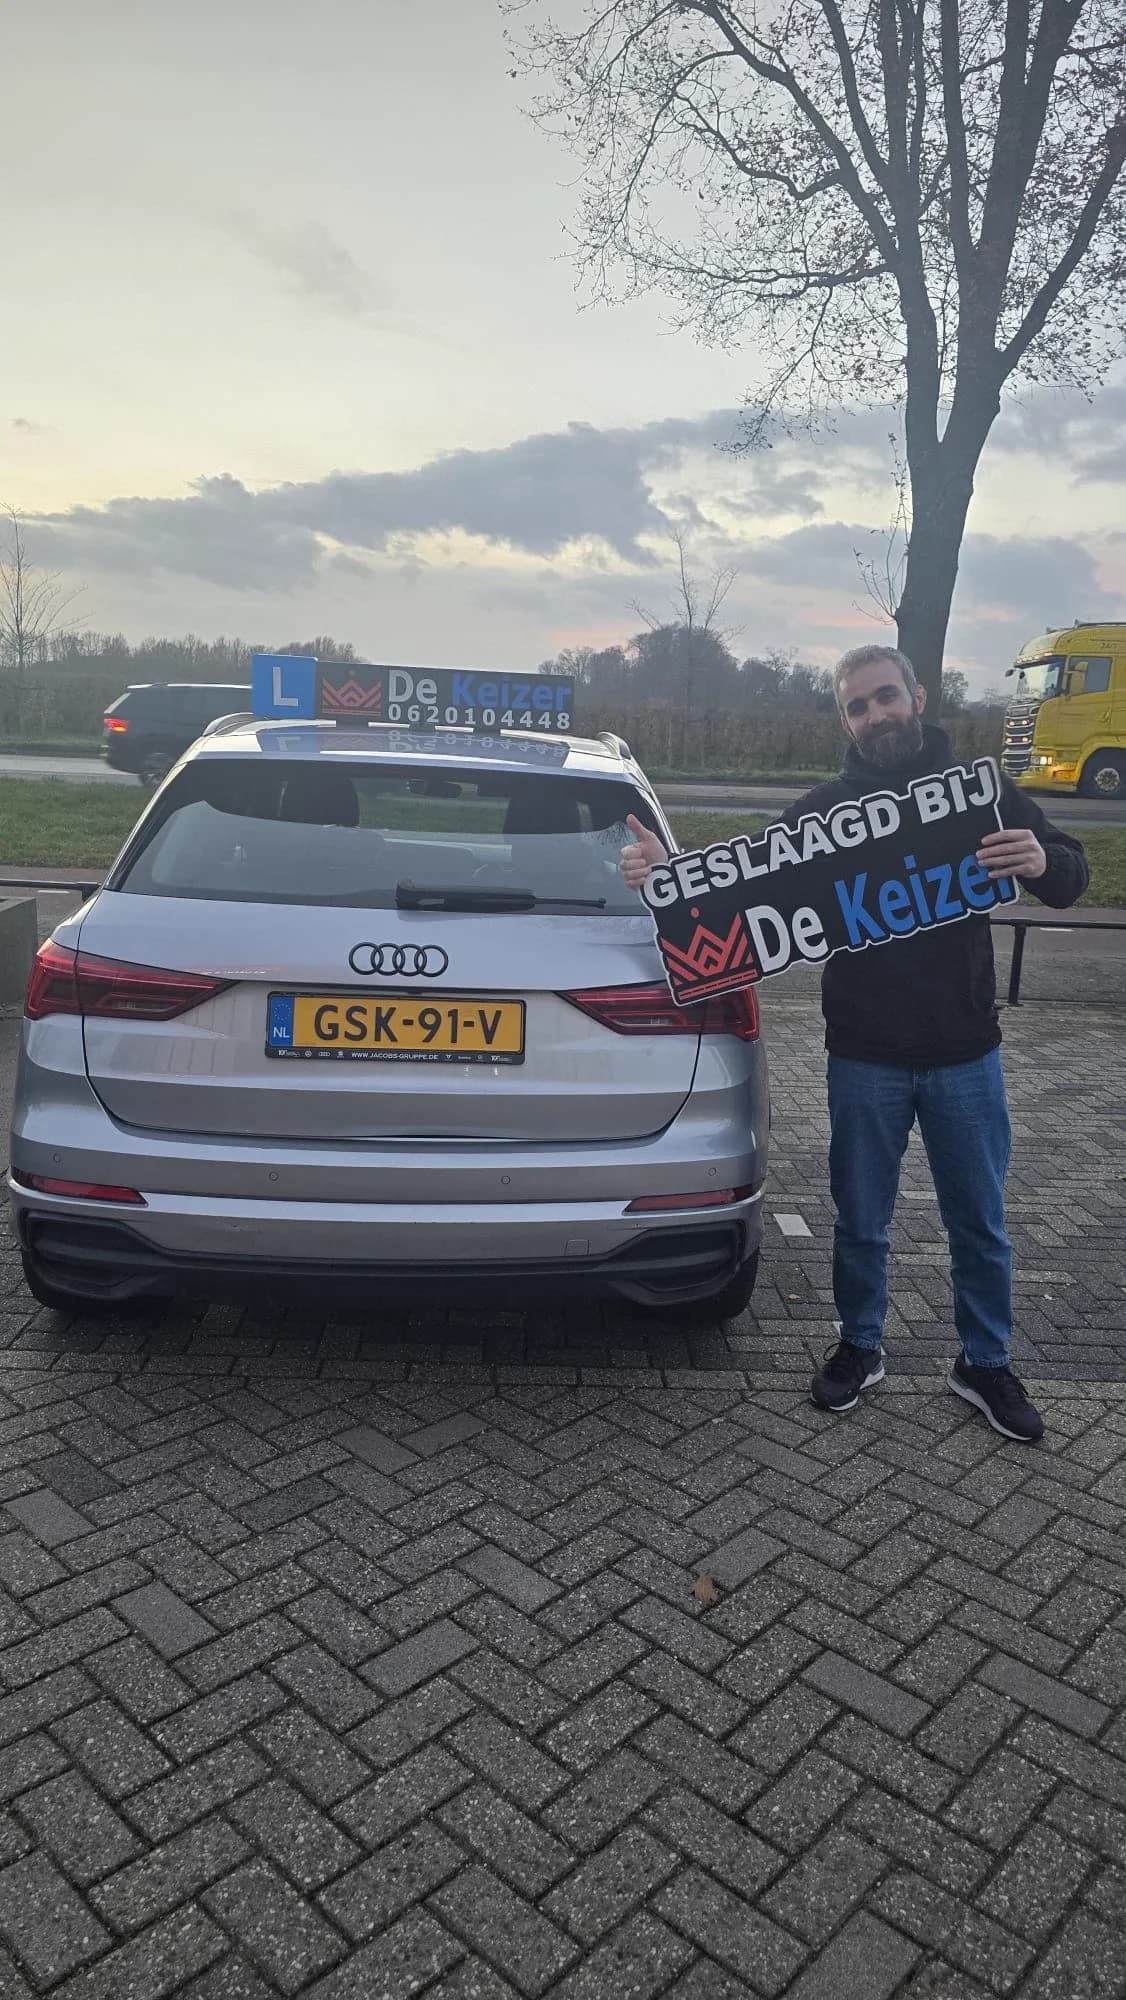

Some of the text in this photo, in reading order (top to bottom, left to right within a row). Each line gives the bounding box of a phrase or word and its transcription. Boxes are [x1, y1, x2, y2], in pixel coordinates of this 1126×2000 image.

[272, 666, 299, 707] L
[388, 669, 573, 711] De Keizer
[388, 703, 571, 730] 0620104448
[643, 765, 995, 908] GESLAAGD BIJ
[744, 904, 829, 973] De
[273, 1026, 291, 1038] NL
[314, 1004, 502, 1045] GSK-91-V
